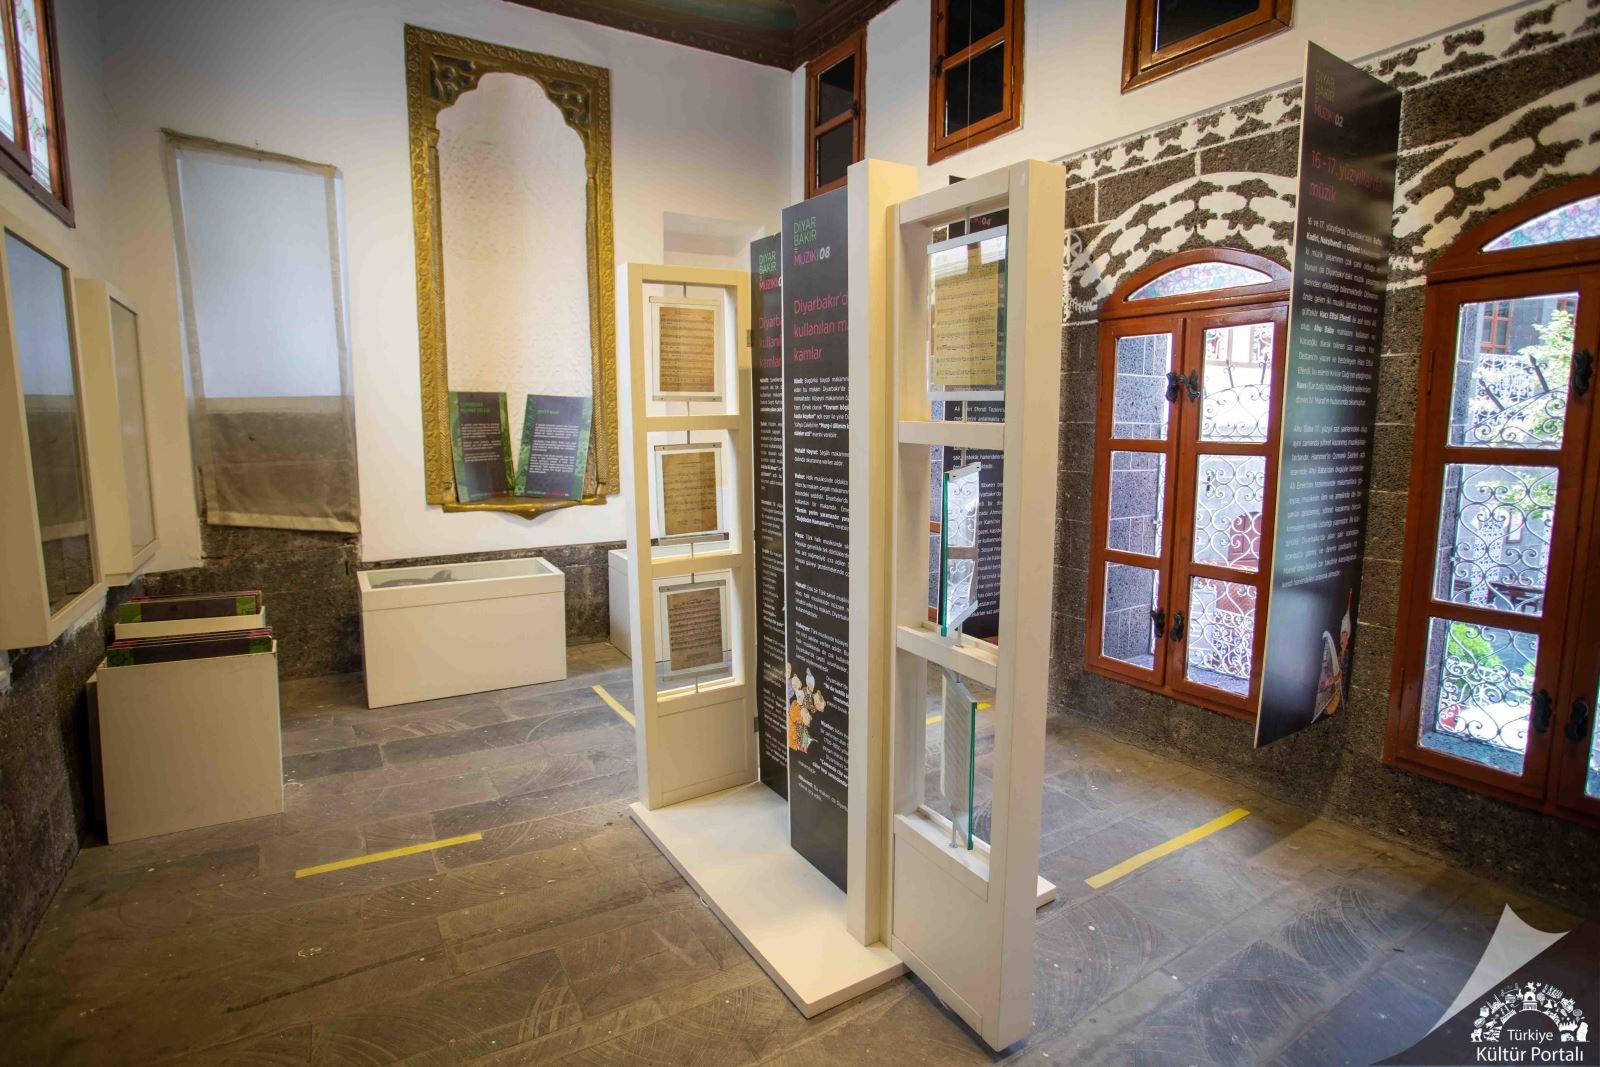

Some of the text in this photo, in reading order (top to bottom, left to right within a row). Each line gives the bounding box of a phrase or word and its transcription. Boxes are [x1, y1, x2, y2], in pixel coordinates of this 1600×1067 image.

[1334, 113, 1344, 128] 02
[1311, 150, 1321, 169] 16
[1310, 181, 1337, 203] müzik
[819, 246, 831, 260] 08
[793, 319, 835, 338] kullanılan
[793, 347, 823, 362] kamlar
